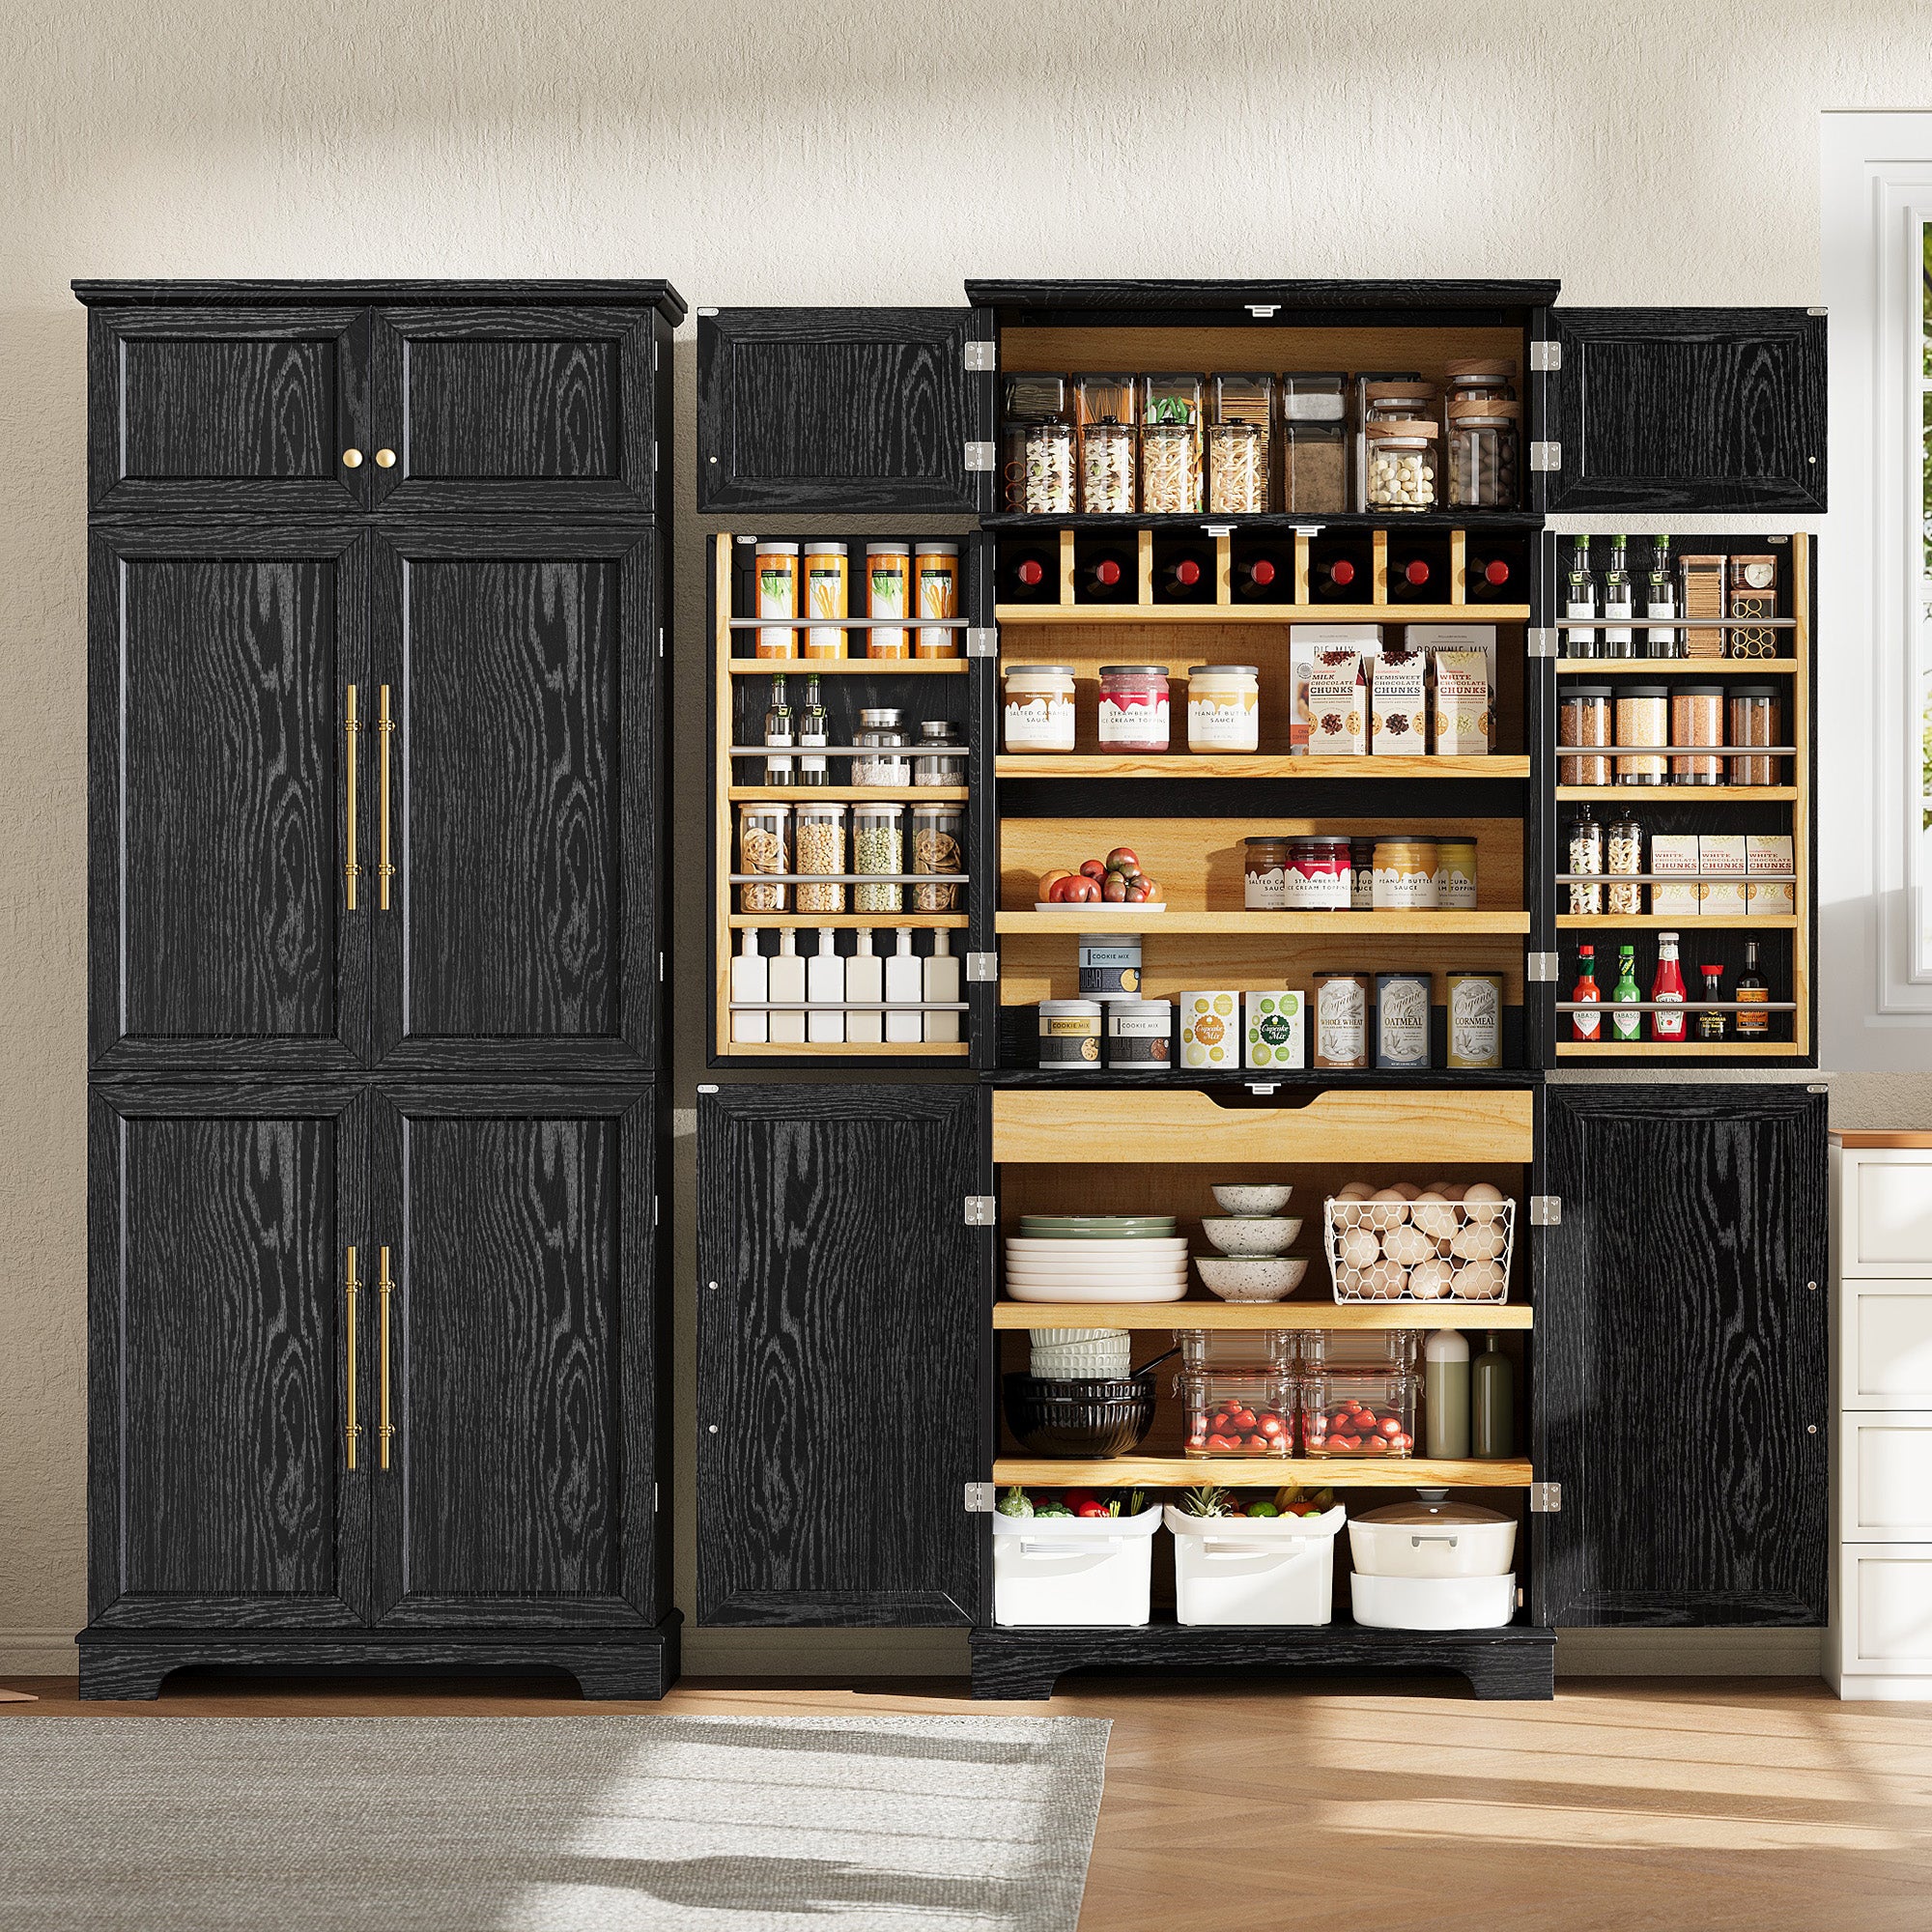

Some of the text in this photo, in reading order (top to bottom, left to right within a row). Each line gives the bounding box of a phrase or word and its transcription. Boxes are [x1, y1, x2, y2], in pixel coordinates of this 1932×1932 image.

[1321, 989, 1360, 1016] Organic
[1383, 989, 1422, 1016] Organic
[1454, 988, 1493, 1015] Organic
[1384, 1017, 1423, 1026] OATMEAL
[1455, 1017, 1495, 1026] CORNMEAL
[1196, 1024, 1223, 1034] Cupcake
[1262, 1024, 1290, 1034] Cupcake
